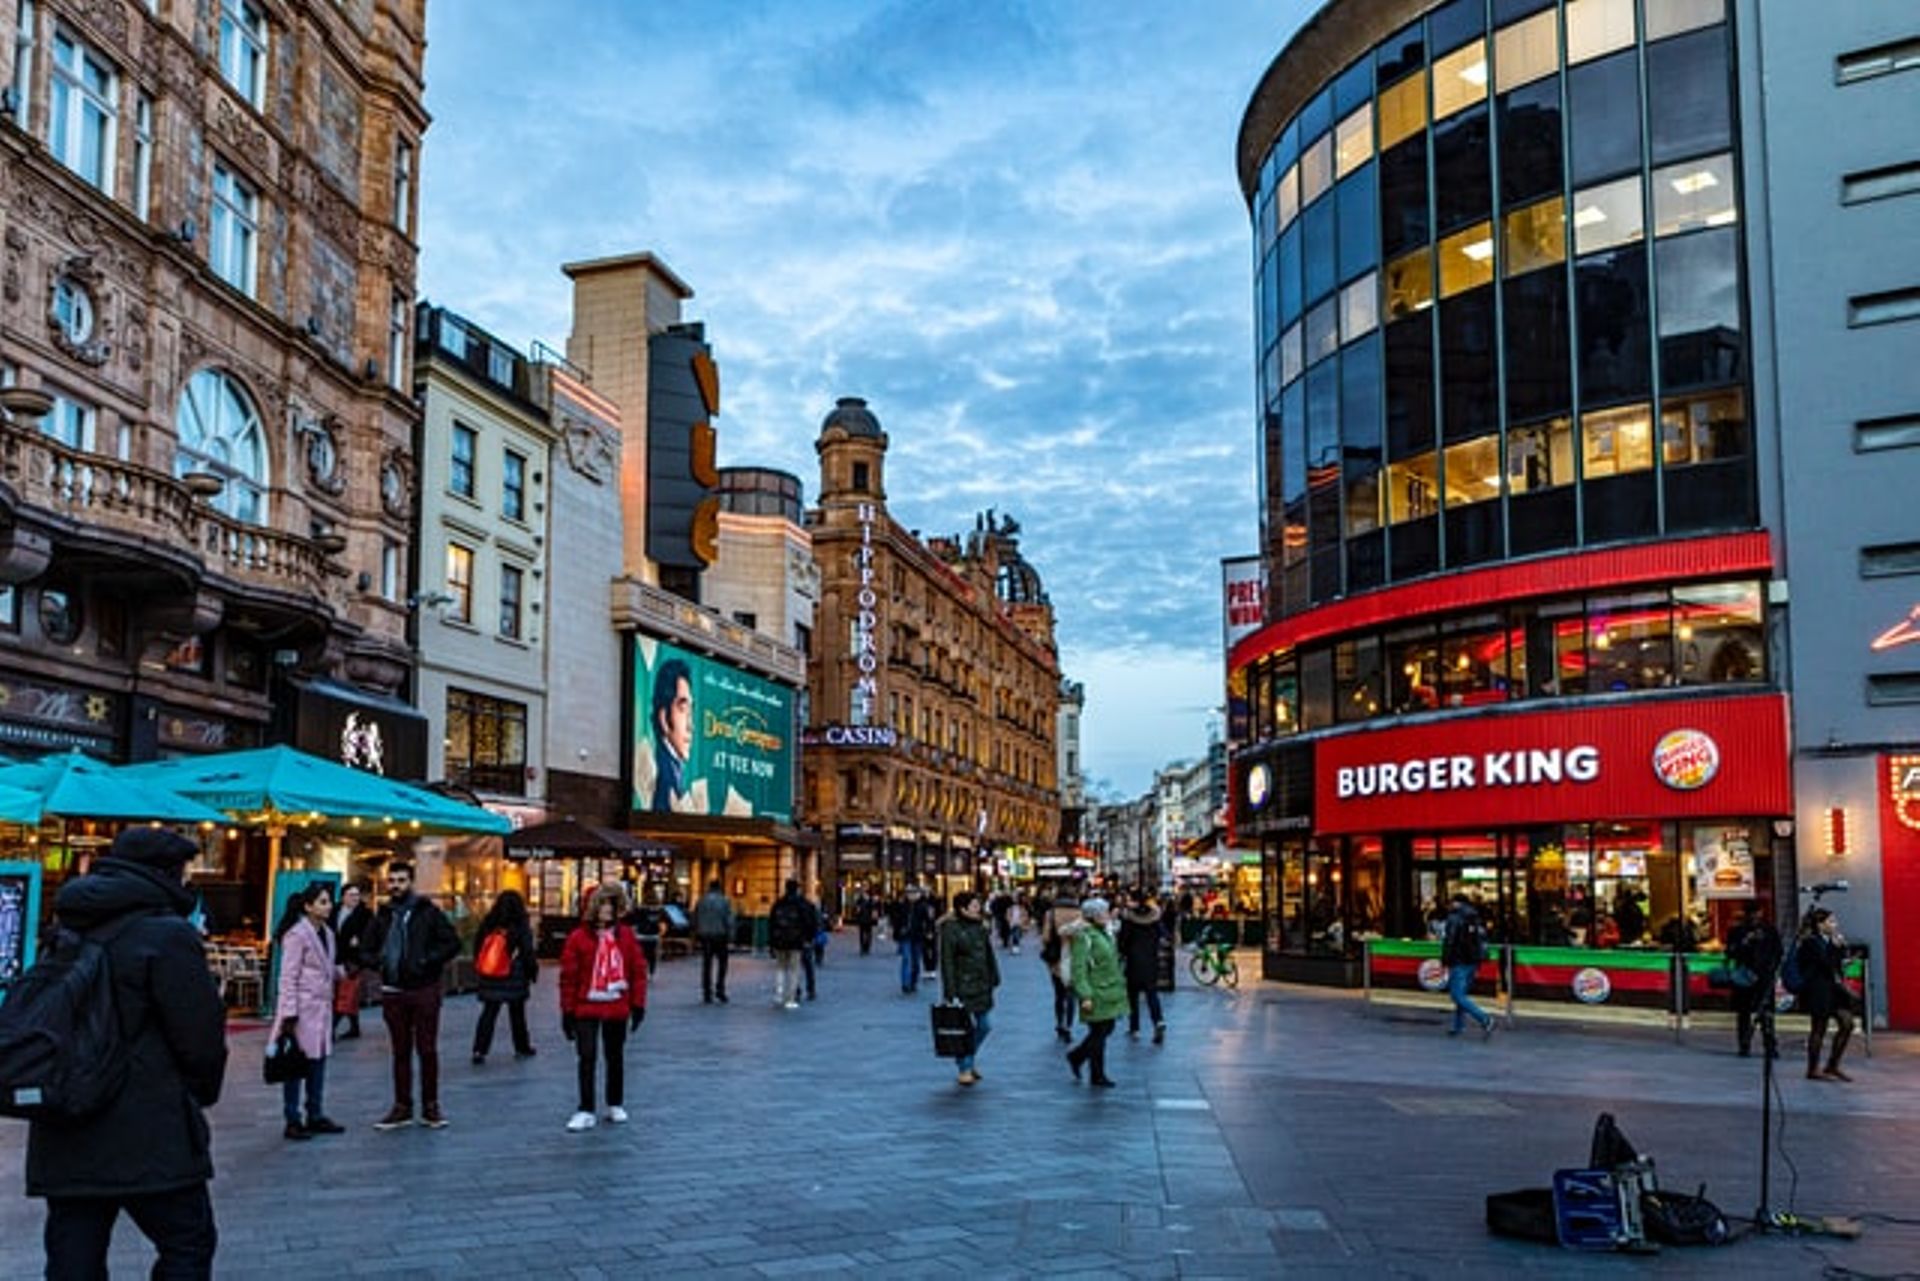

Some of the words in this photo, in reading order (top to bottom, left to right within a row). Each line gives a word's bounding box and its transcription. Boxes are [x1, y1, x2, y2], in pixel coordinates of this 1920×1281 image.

[858, 503, 877, 717] HIPPODROME
[1337, 756, 1476, 798] BURGER
[1484, 745, 1600, 786] KING
